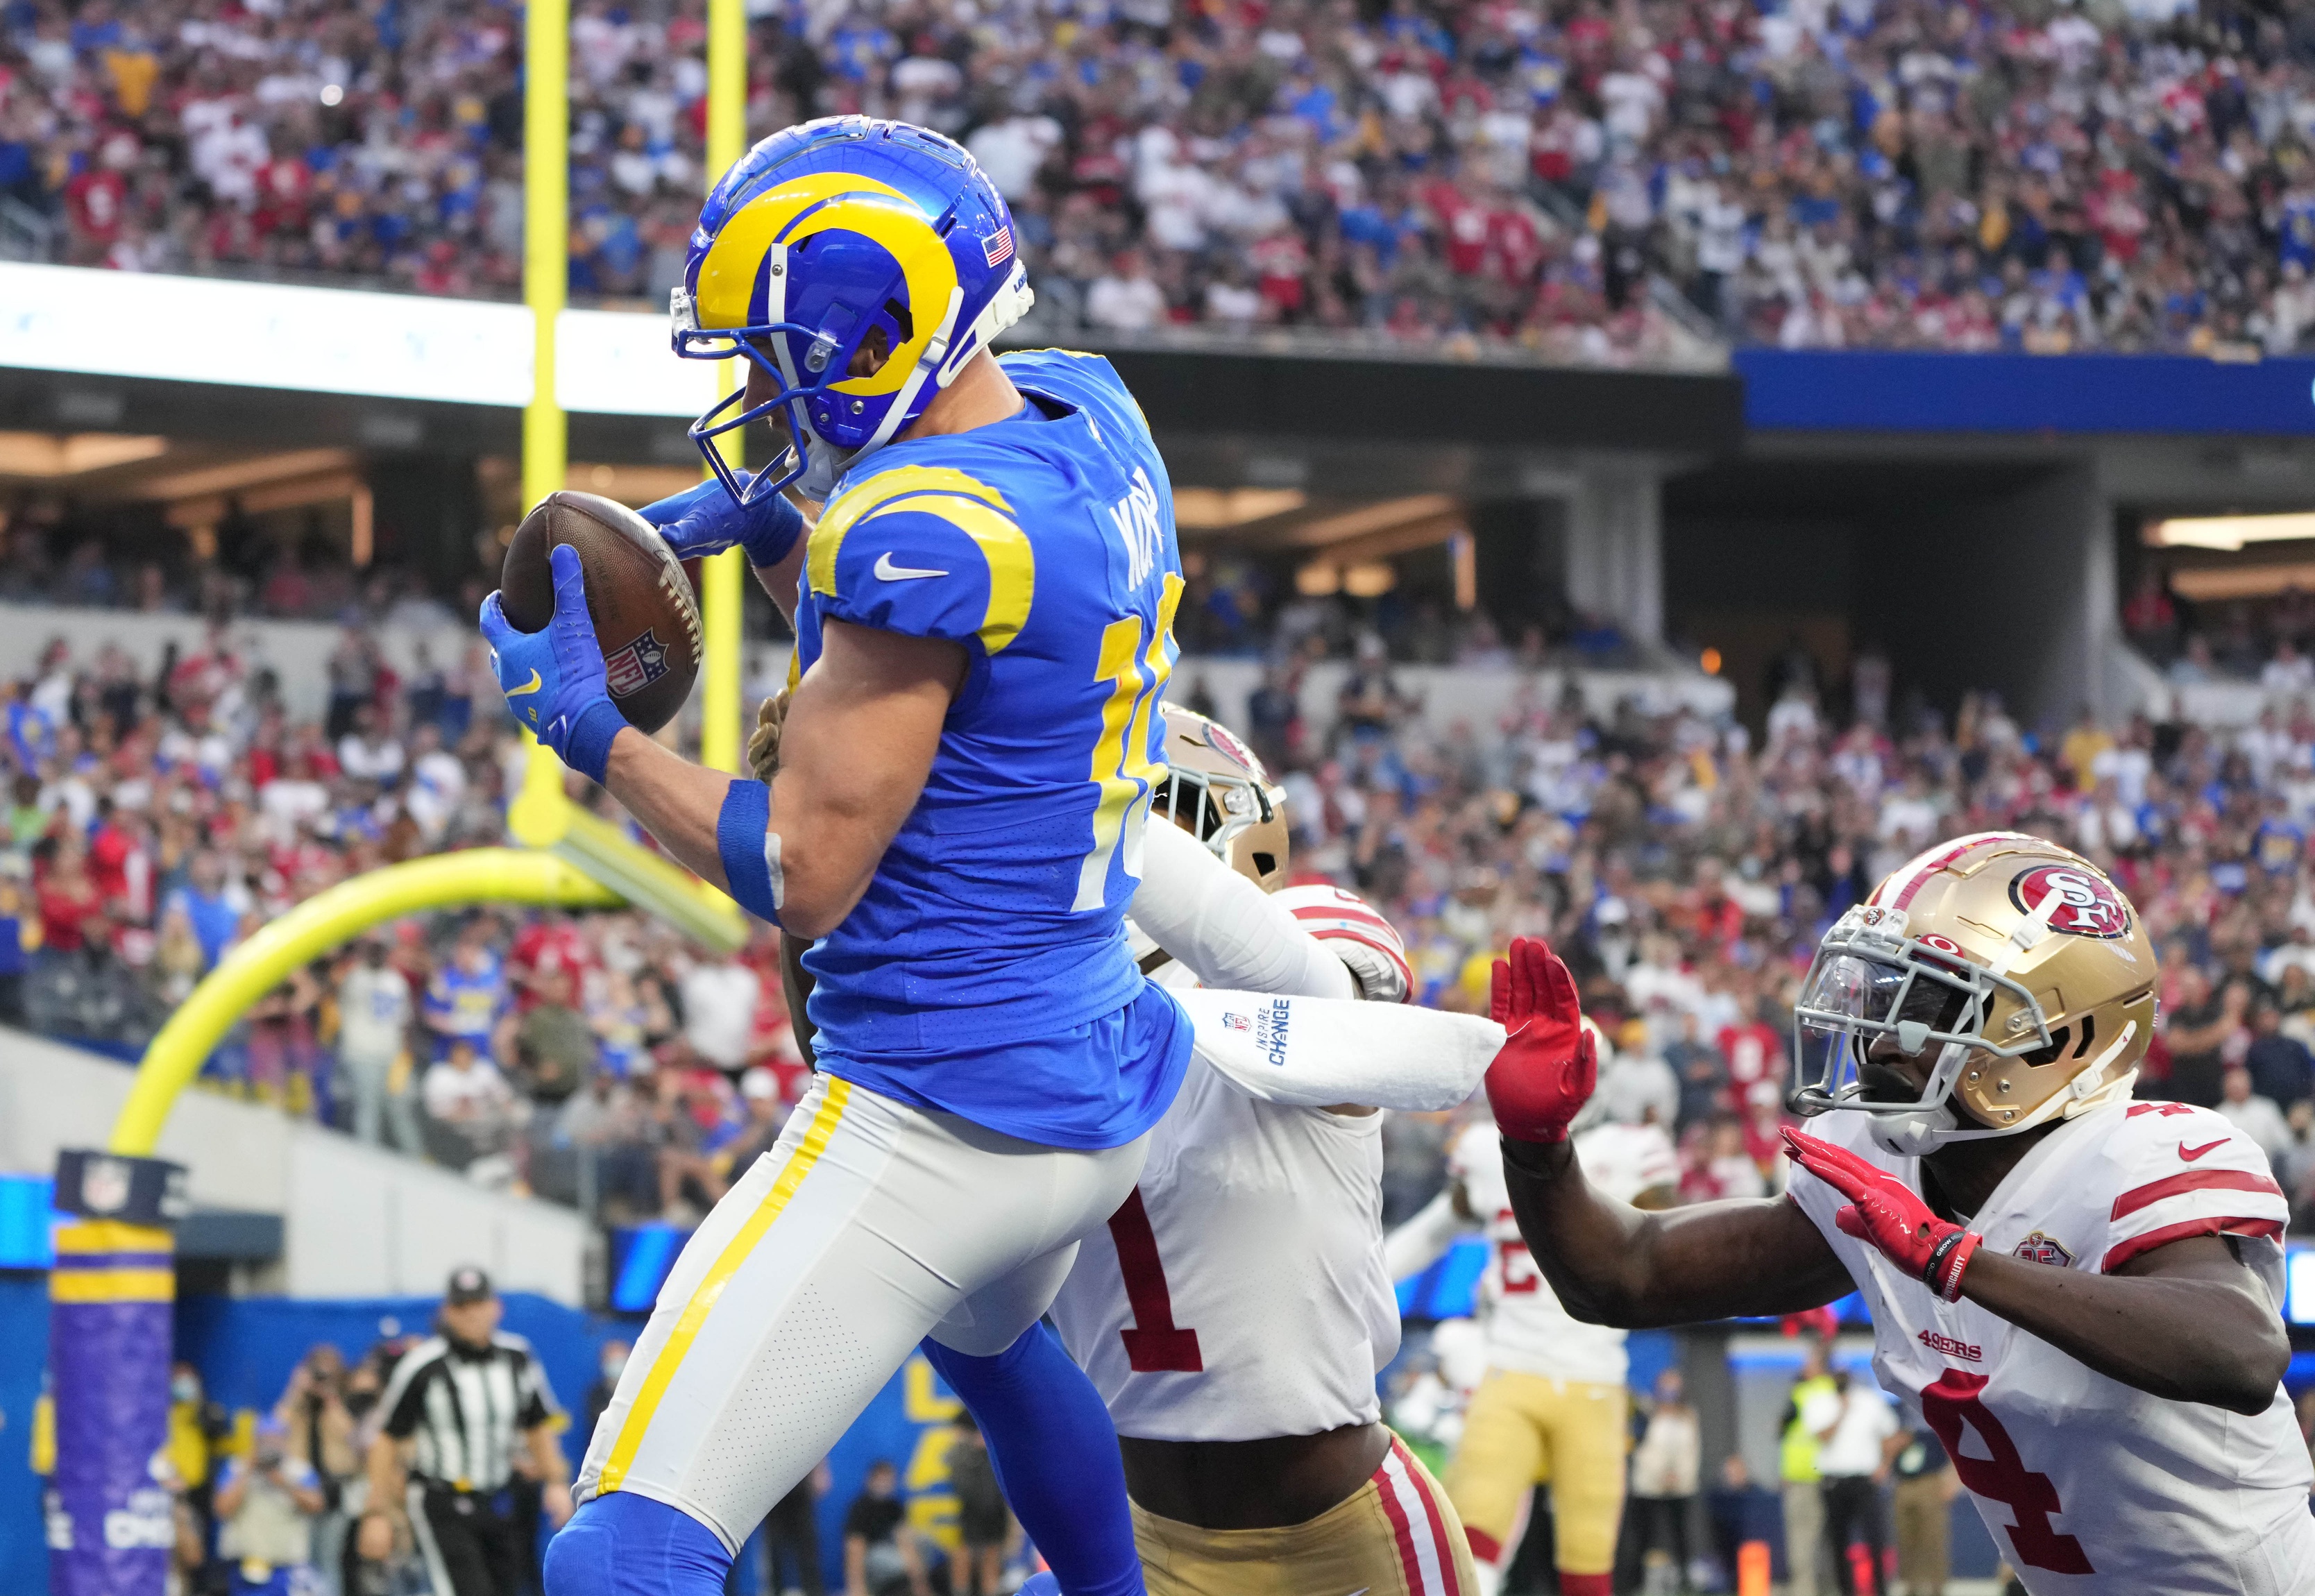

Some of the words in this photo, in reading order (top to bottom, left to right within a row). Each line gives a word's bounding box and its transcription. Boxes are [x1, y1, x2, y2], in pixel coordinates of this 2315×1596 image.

[607, 649, 644, 693] NFL
[2044, 872, 2118, 929] SF
[1235, 1017, 1249, 1031] NFL
[1255, 1007, 1270, 1051] INSPIRE
[1269, 999, 1290, 1067] CHANGE
[1936, 1239, 1952, 1257] GROW
[1917, 1330, 1983, 1360] 49ERS
[1919, 1367, 2097, 1574] 4
